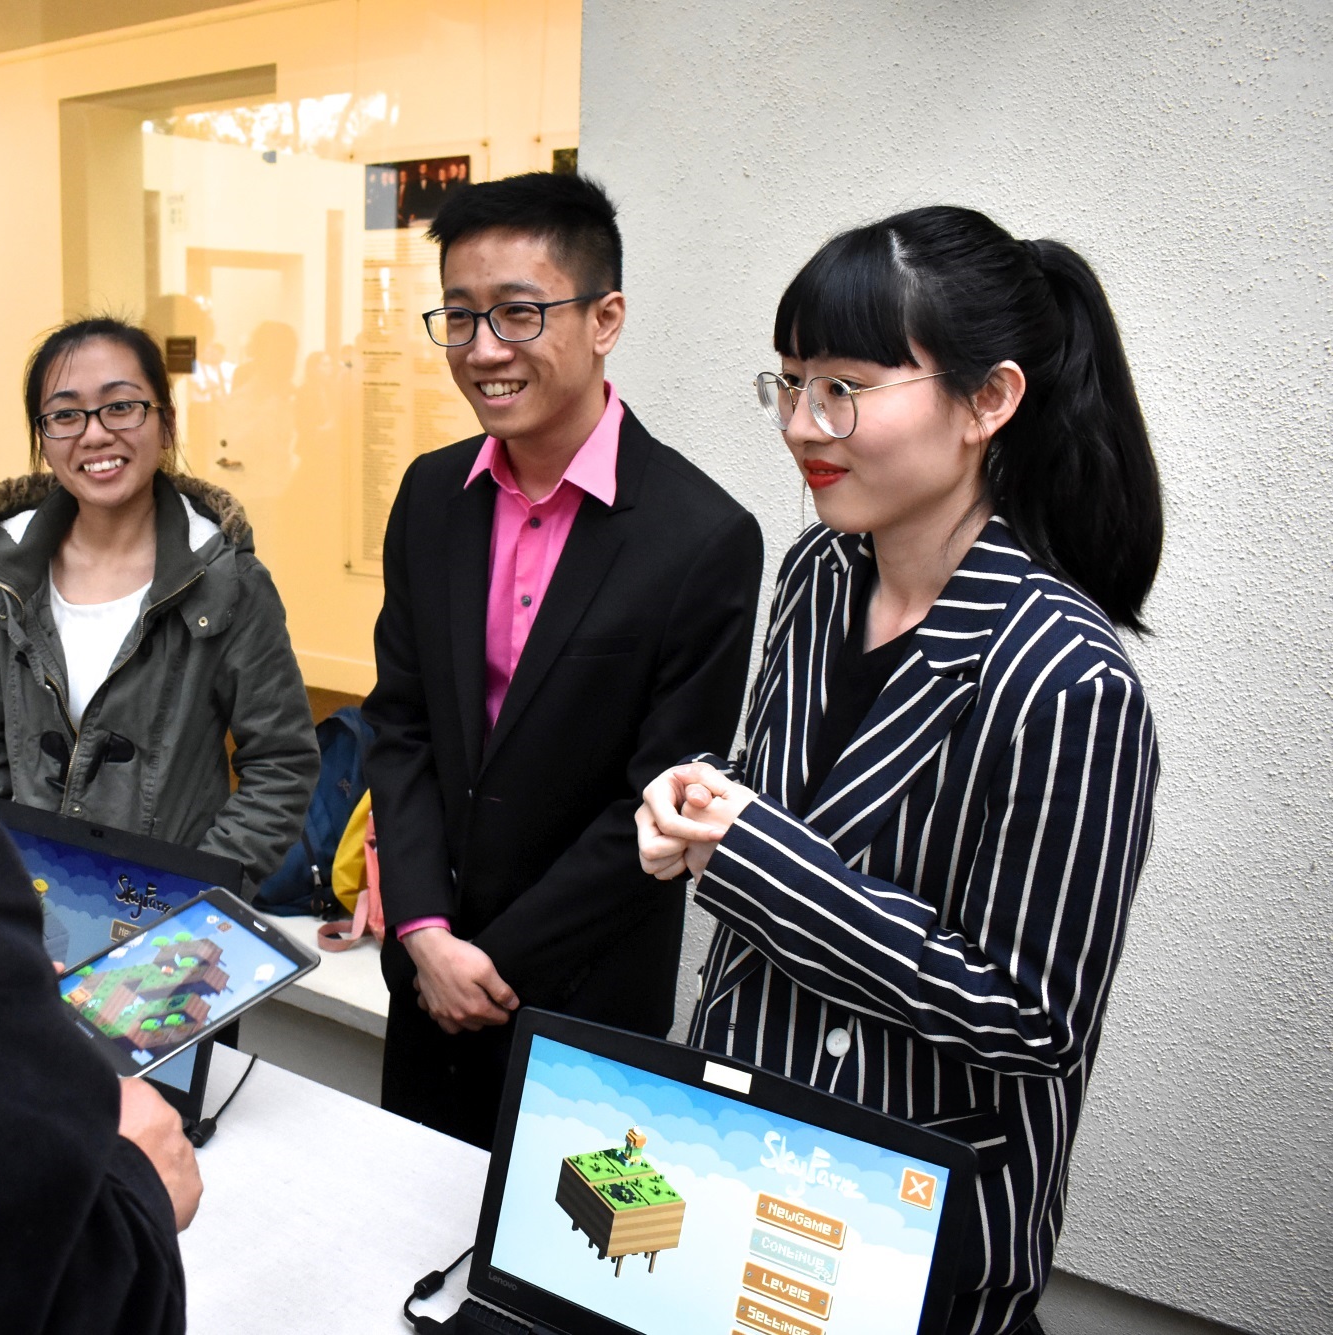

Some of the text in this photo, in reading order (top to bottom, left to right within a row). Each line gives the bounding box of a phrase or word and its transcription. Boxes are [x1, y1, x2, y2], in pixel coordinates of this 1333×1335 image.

[760, 1131, 865, 1198] SkyFarm
[489, 1272, 517, 1290] Lenovo
[762, 1272, 810, 1302] Levels
